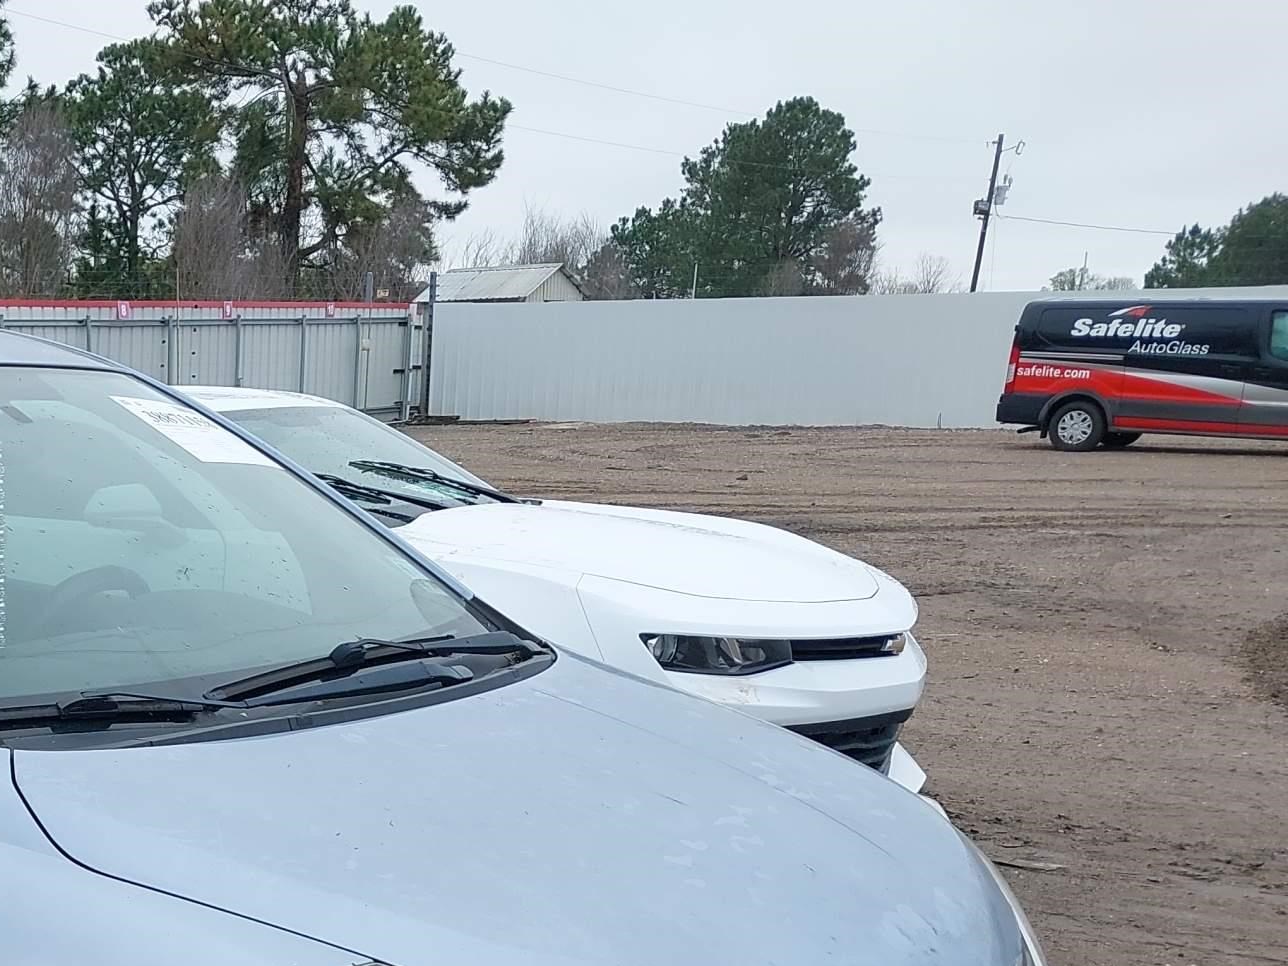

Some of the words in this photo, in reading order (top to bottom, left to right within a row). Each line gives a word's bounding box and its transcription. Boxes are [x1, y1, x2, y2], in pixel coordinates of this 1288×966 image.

[1071, 318, 1181, 338] Safelite
[1127, 340, 1210, 355] AutoGlass
[1016, 364, 1090, 379] safelite.com
